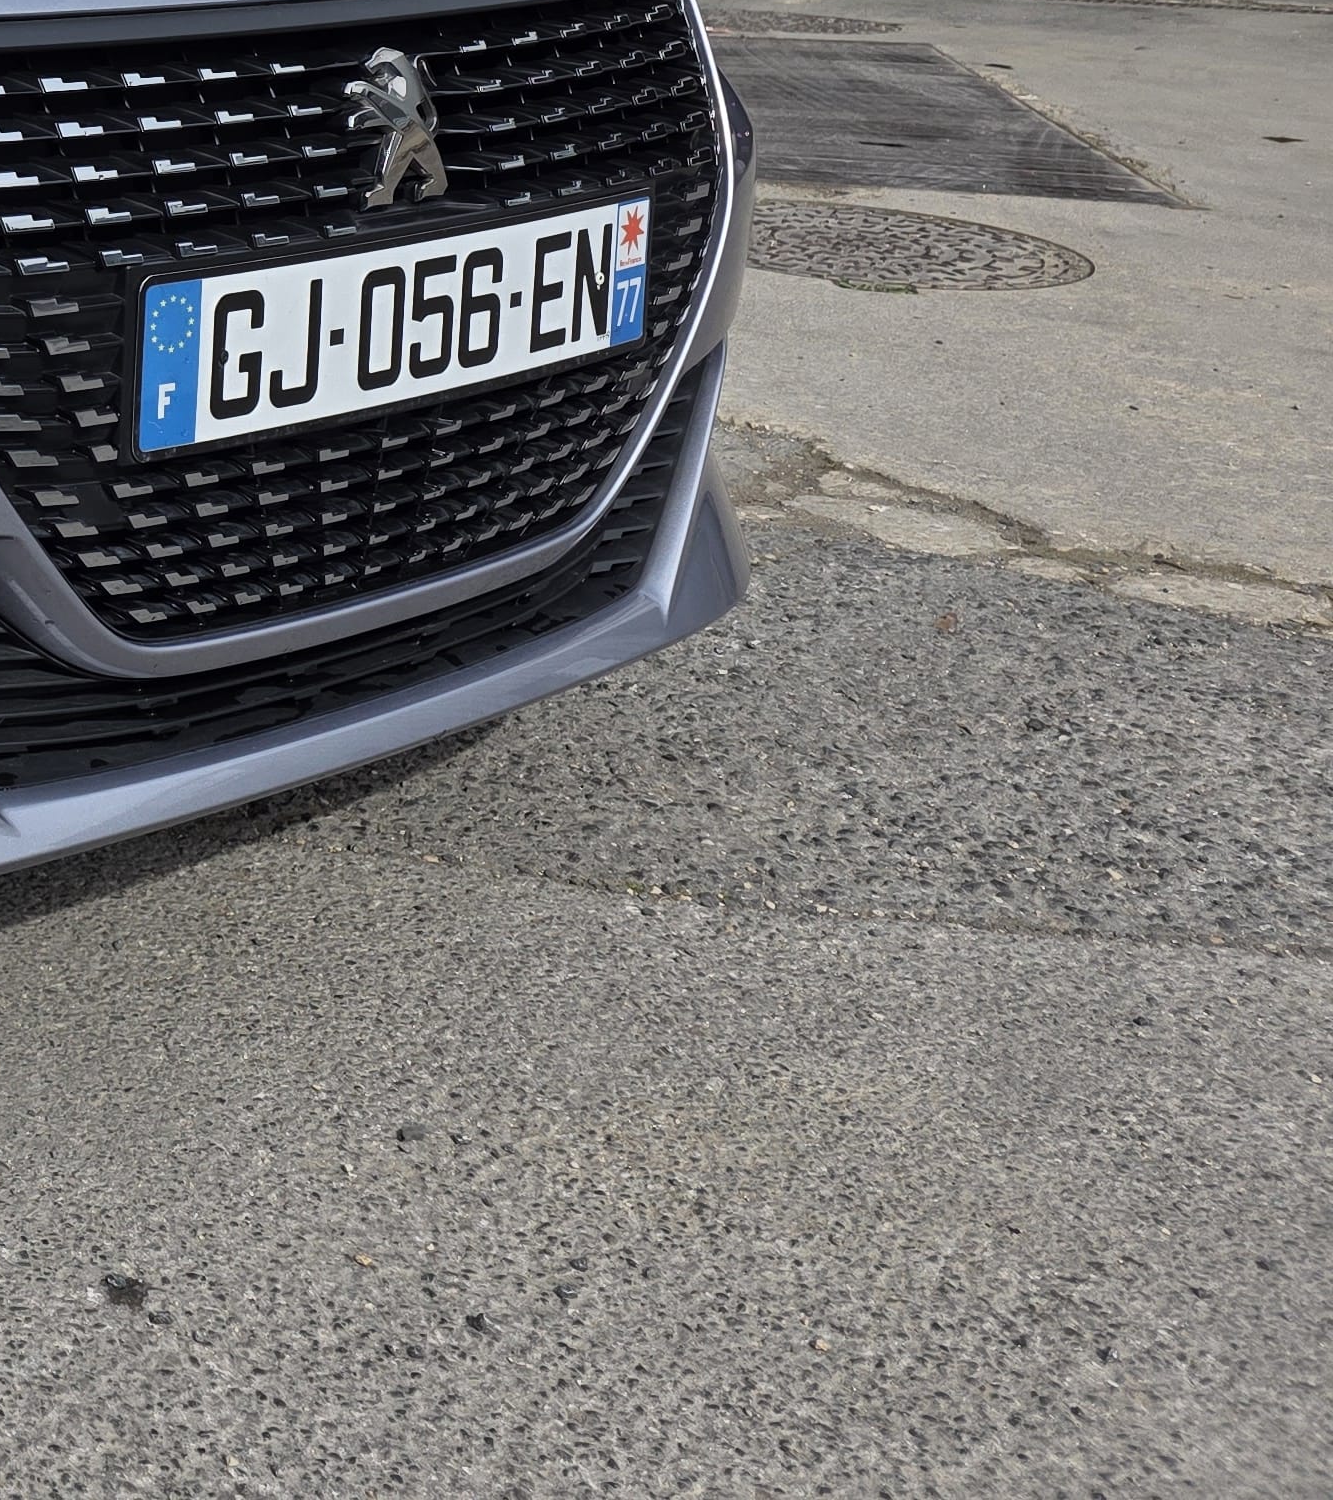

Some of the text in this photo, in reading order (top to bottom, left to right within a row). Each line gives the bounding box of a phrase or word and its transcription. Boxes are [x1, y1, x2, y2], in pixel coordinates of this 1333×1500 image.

[157, 223, 642, 420] F GJ-056-EN 77
